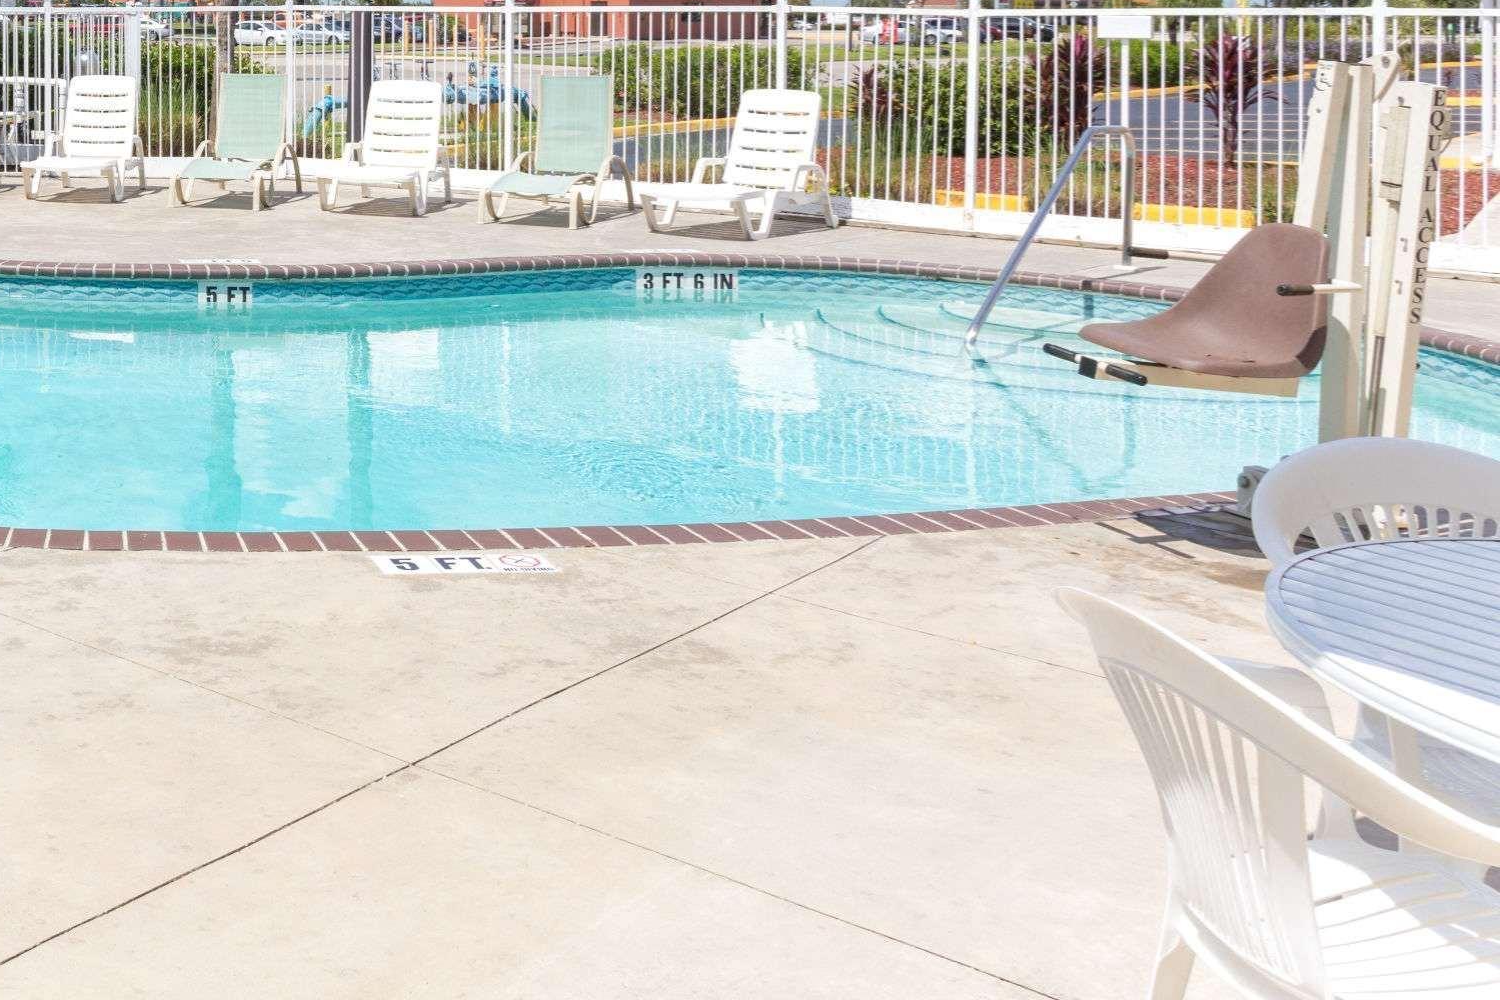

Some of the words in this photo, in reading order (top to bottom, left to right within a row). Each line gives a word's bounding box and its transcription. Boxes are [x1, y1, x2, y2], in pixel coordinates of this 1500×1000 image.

[1423, 89, 1446, 192] EQUAL
[1409, 207, 1433, 324] ACCESS
[643, 272, 654, 289] 3
[662, 272, 684, 289] FT
[694, 273, 704, 289] 6
[713, 273, 733, 290] IN
[205, 286, 218, 303] 5
[227, 286, 250, 303] FT
[389, 558, 420, 571] 5
